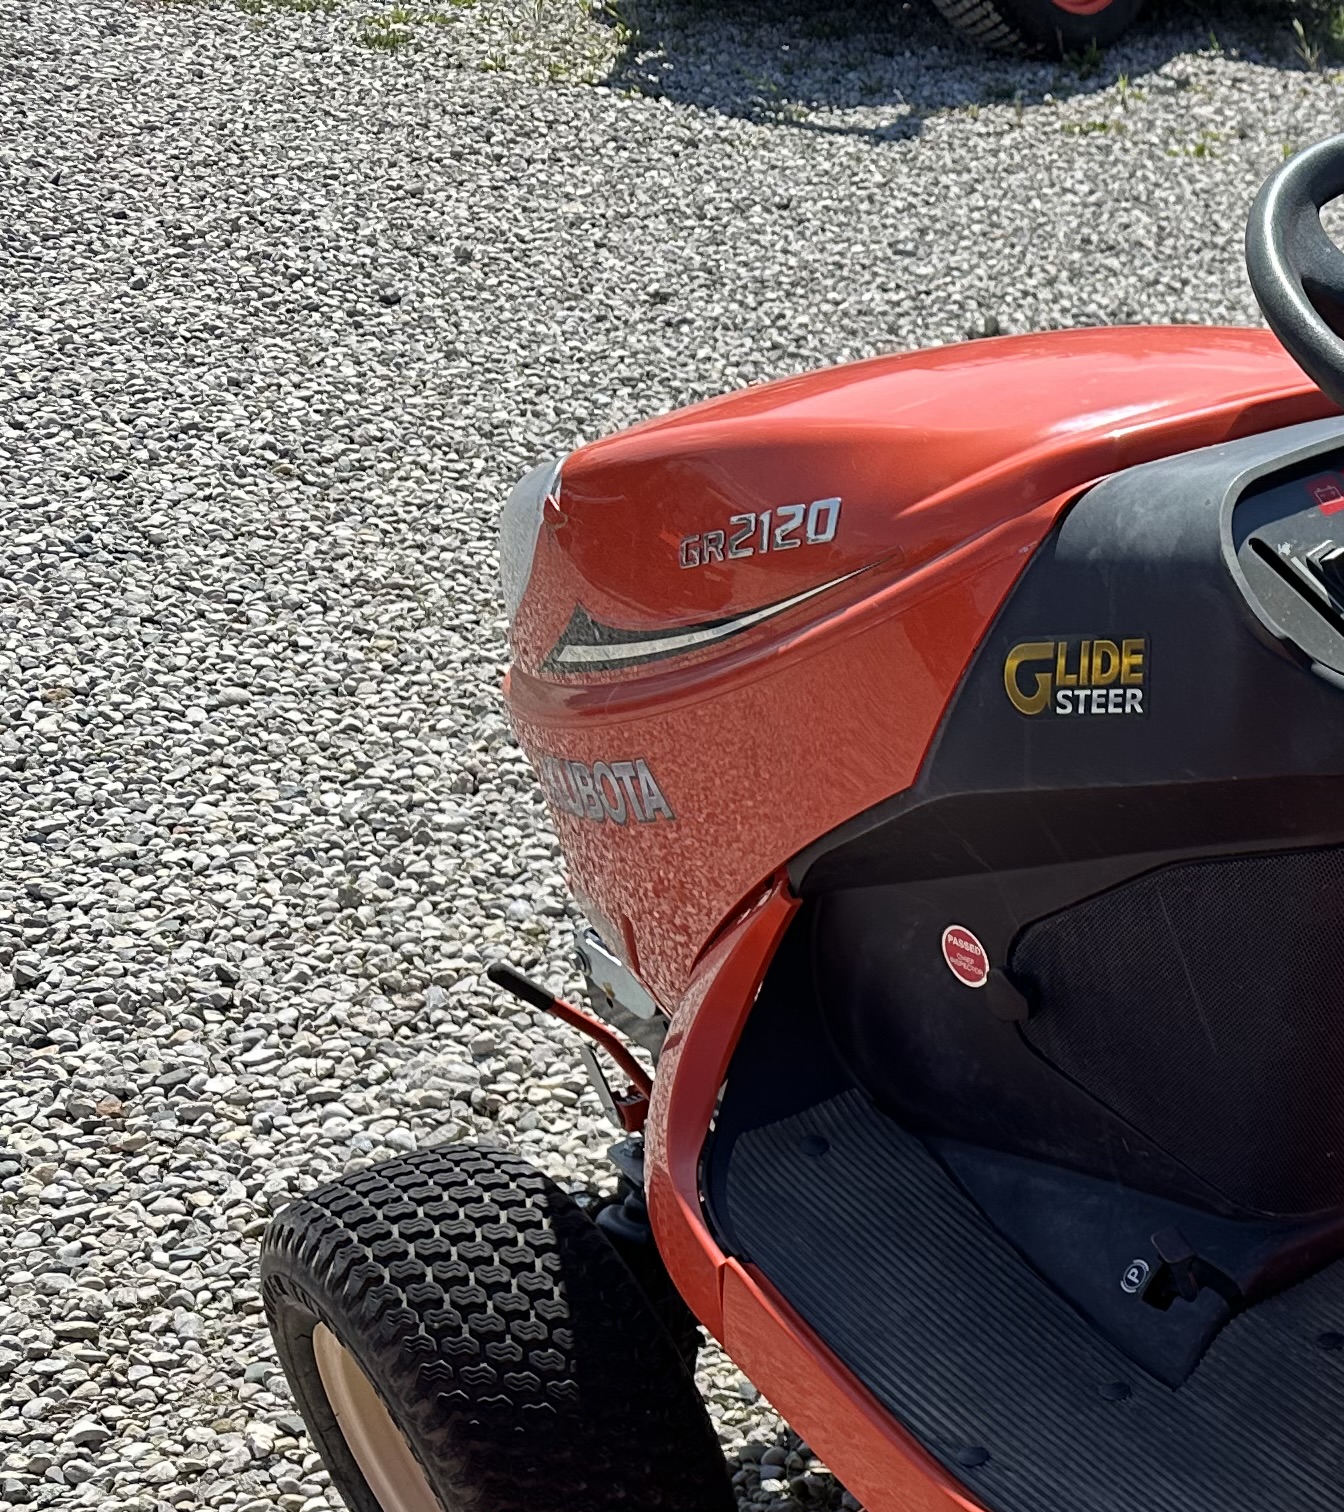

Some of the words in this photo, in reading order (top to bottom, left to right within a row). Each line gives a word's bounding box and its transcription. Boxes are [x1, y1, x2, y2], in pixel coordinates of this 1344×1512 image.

[680, 496, 842, 570] GR2120
[1004, 638, 1146, 716] GLIDE
[1055, 687, 1144, 715] STEER
[541, 756, 676, 826] KUBOTA
[947, 933, 981, 956] PASSED
